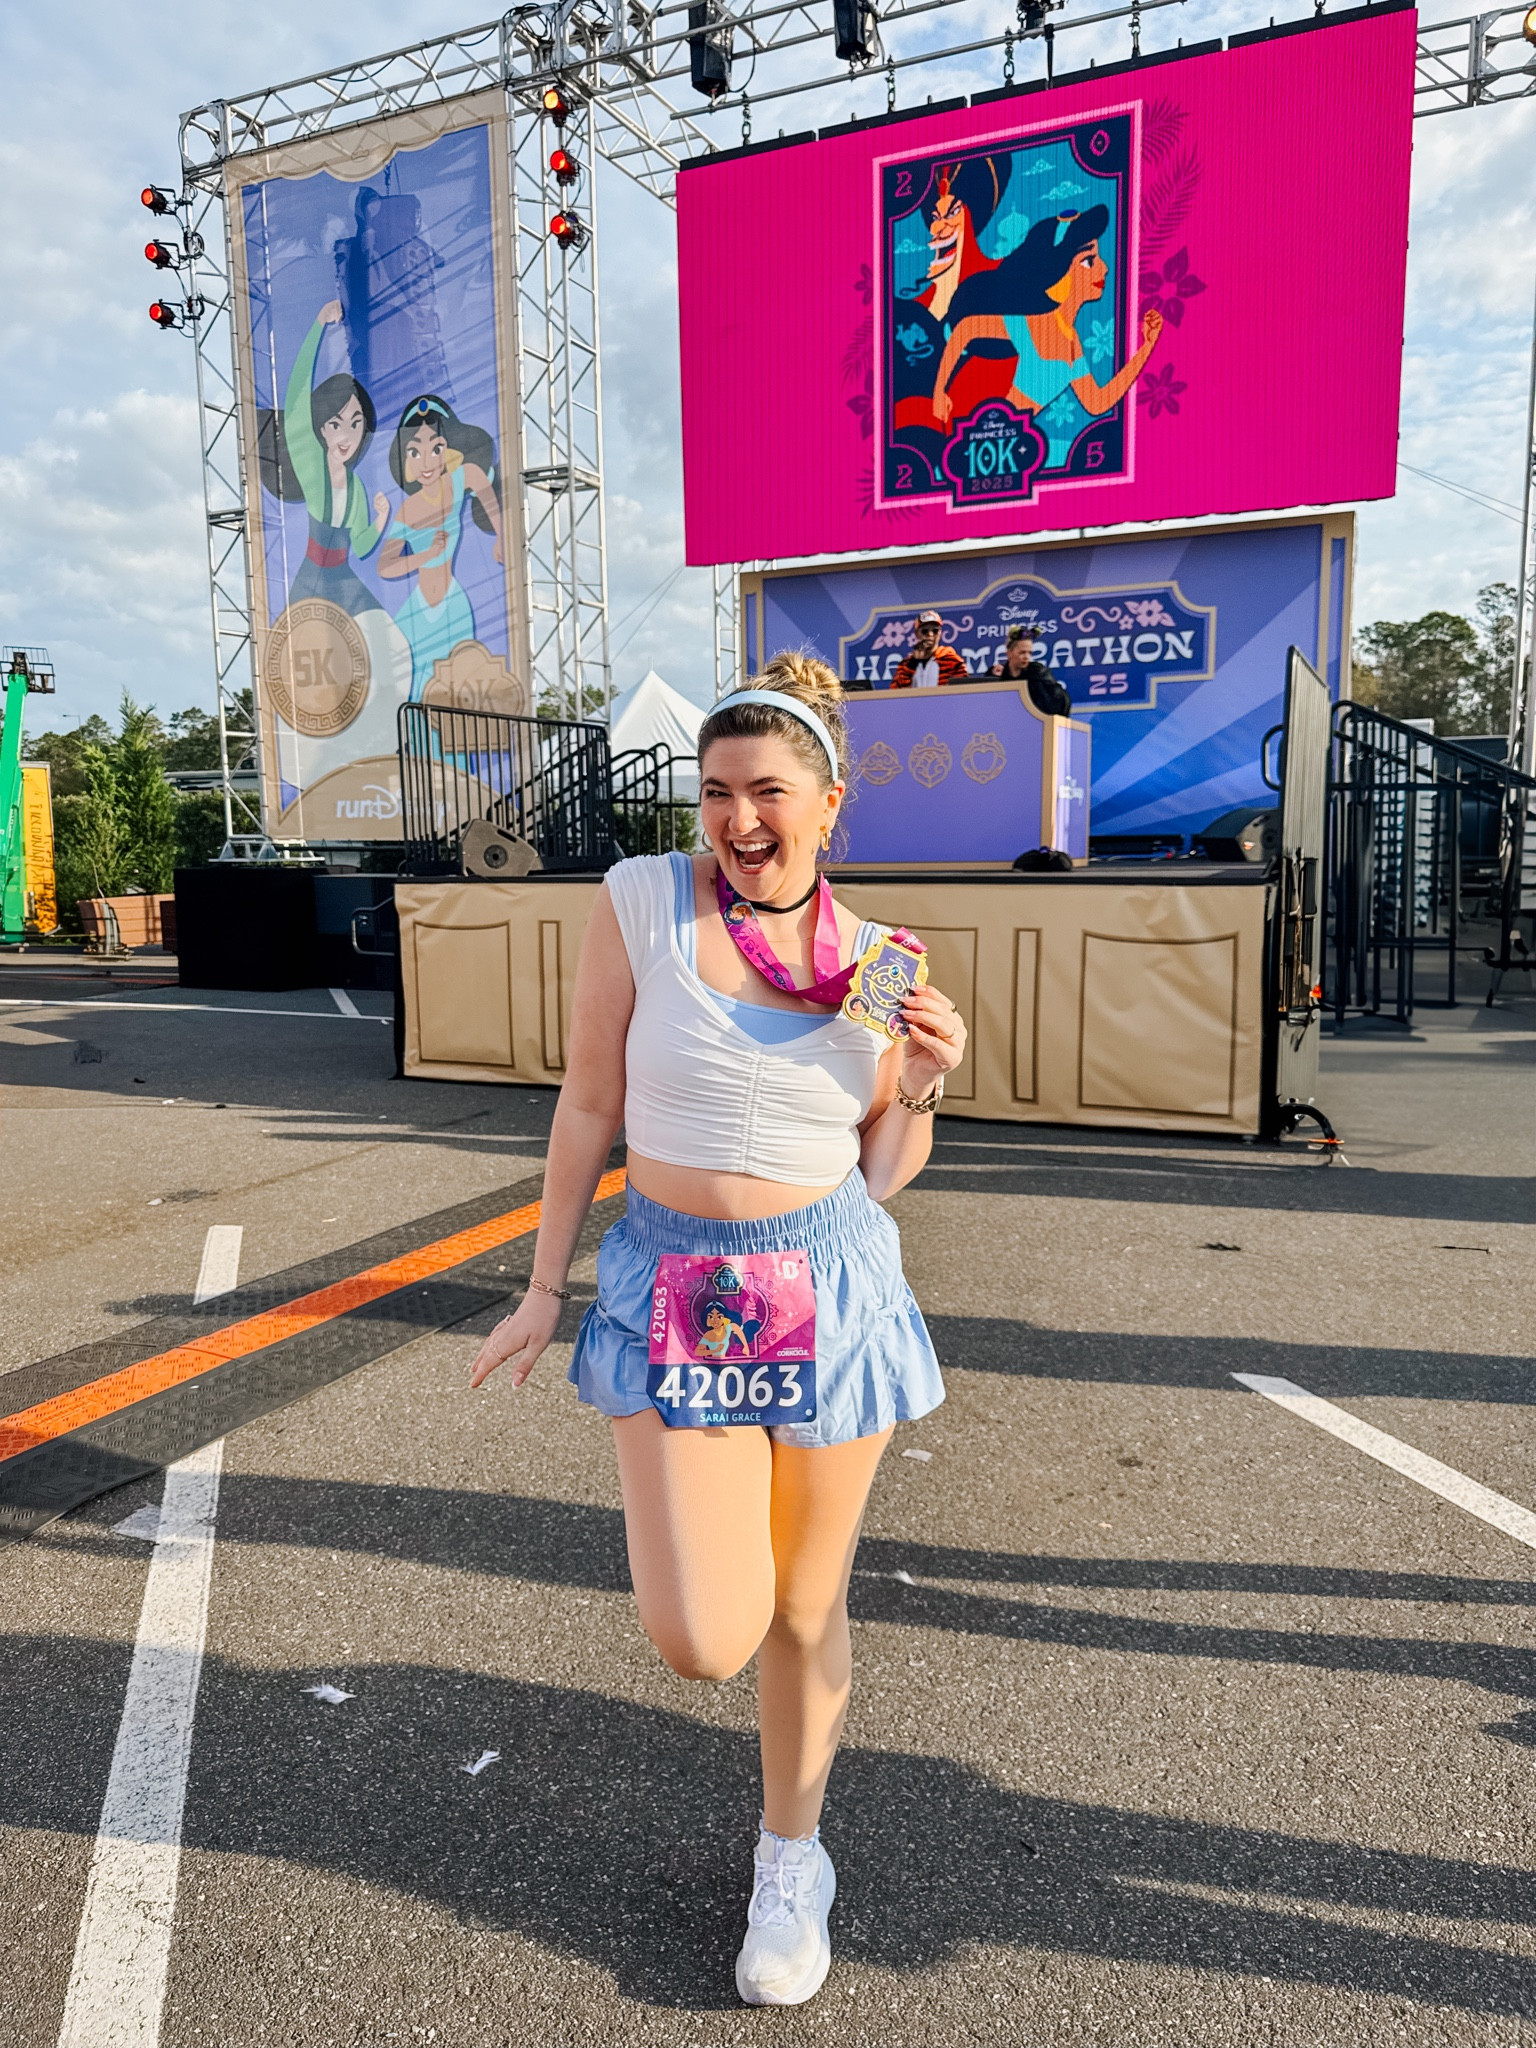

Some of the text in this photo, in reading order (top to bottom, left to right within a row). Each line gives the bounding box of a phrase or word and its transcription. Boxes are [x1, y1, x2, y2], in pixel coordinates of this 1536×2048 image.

[894, 170, 913, 198] 2
[968, 427, 1018, 441] PRINCESS
[963, 437, 1020, 479] 10K
[1084, 440, 1106, 469] 5
[895, 463, 913, 489] 2
[970, 474, 1014, 493] 2025
[996, 604, 1040, 622] Disney
[292, 647, 338, 689] 5K
[1088, 672, 1130, 697] 25
[719, 1276, 736, 1288] 10K
[651, 1286, 668, 1344] 42063
[655, 1364, 803, 1409] 42063
[699, 1412, 761, 1423] SARAI GRACE
